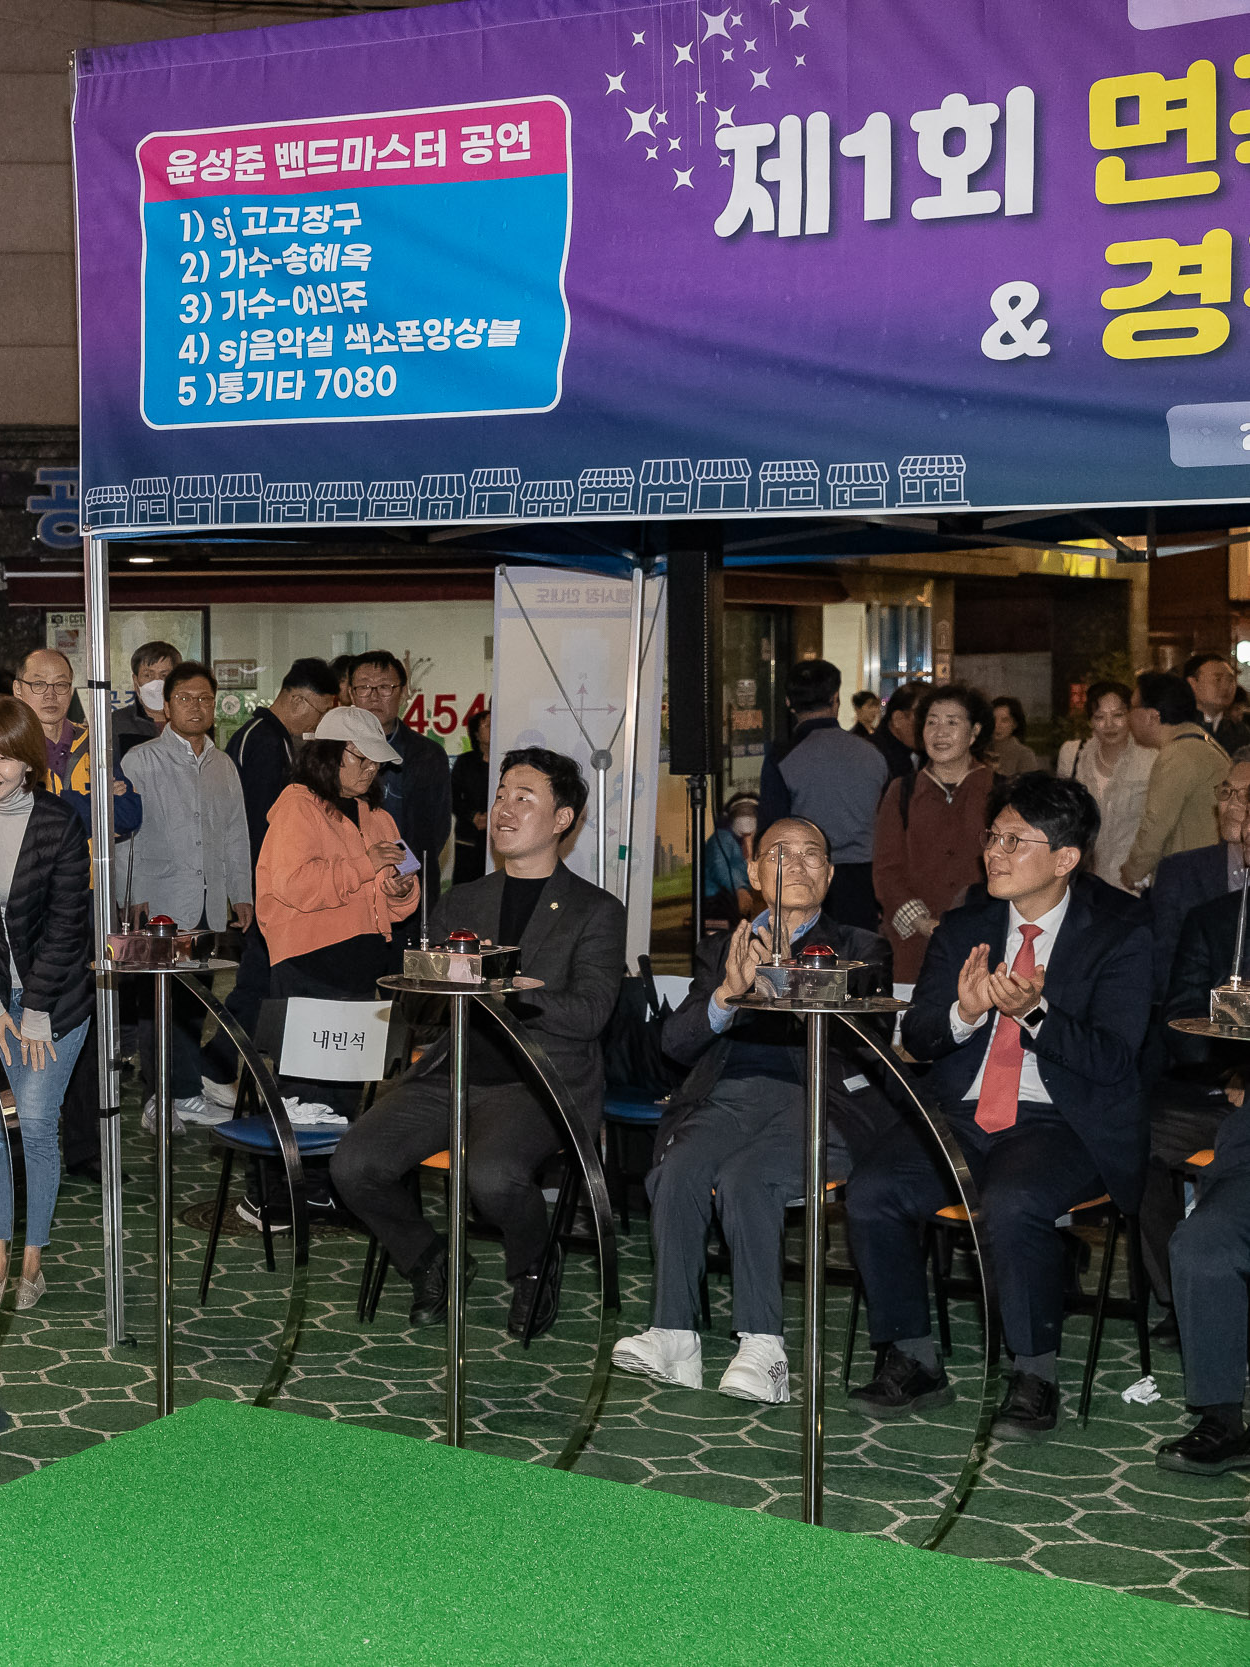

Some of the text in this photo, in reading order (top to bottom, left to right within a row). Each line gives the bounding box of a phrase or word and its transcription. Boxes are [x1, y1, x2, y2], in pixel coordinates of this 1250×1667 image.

[166, 120, 531, 185] 윤성준 밴드마스터 공연
[714, 54, 1250, 238] 제1회 면
[180, 202, 362, 246] 1) sj 고고장구
[180, 243, 372, 283] 2) 가수-송혜옥
[179, 281, 368, 324] 3) 가수-여의주
[981, 229, 1250, 360] & 경
[178, 318, 521, 369] 4) sj음악실 색소폰앙상블
[314, 364, 397, 400] 7080
[312, 1030, 366, 1052] 내빈석
